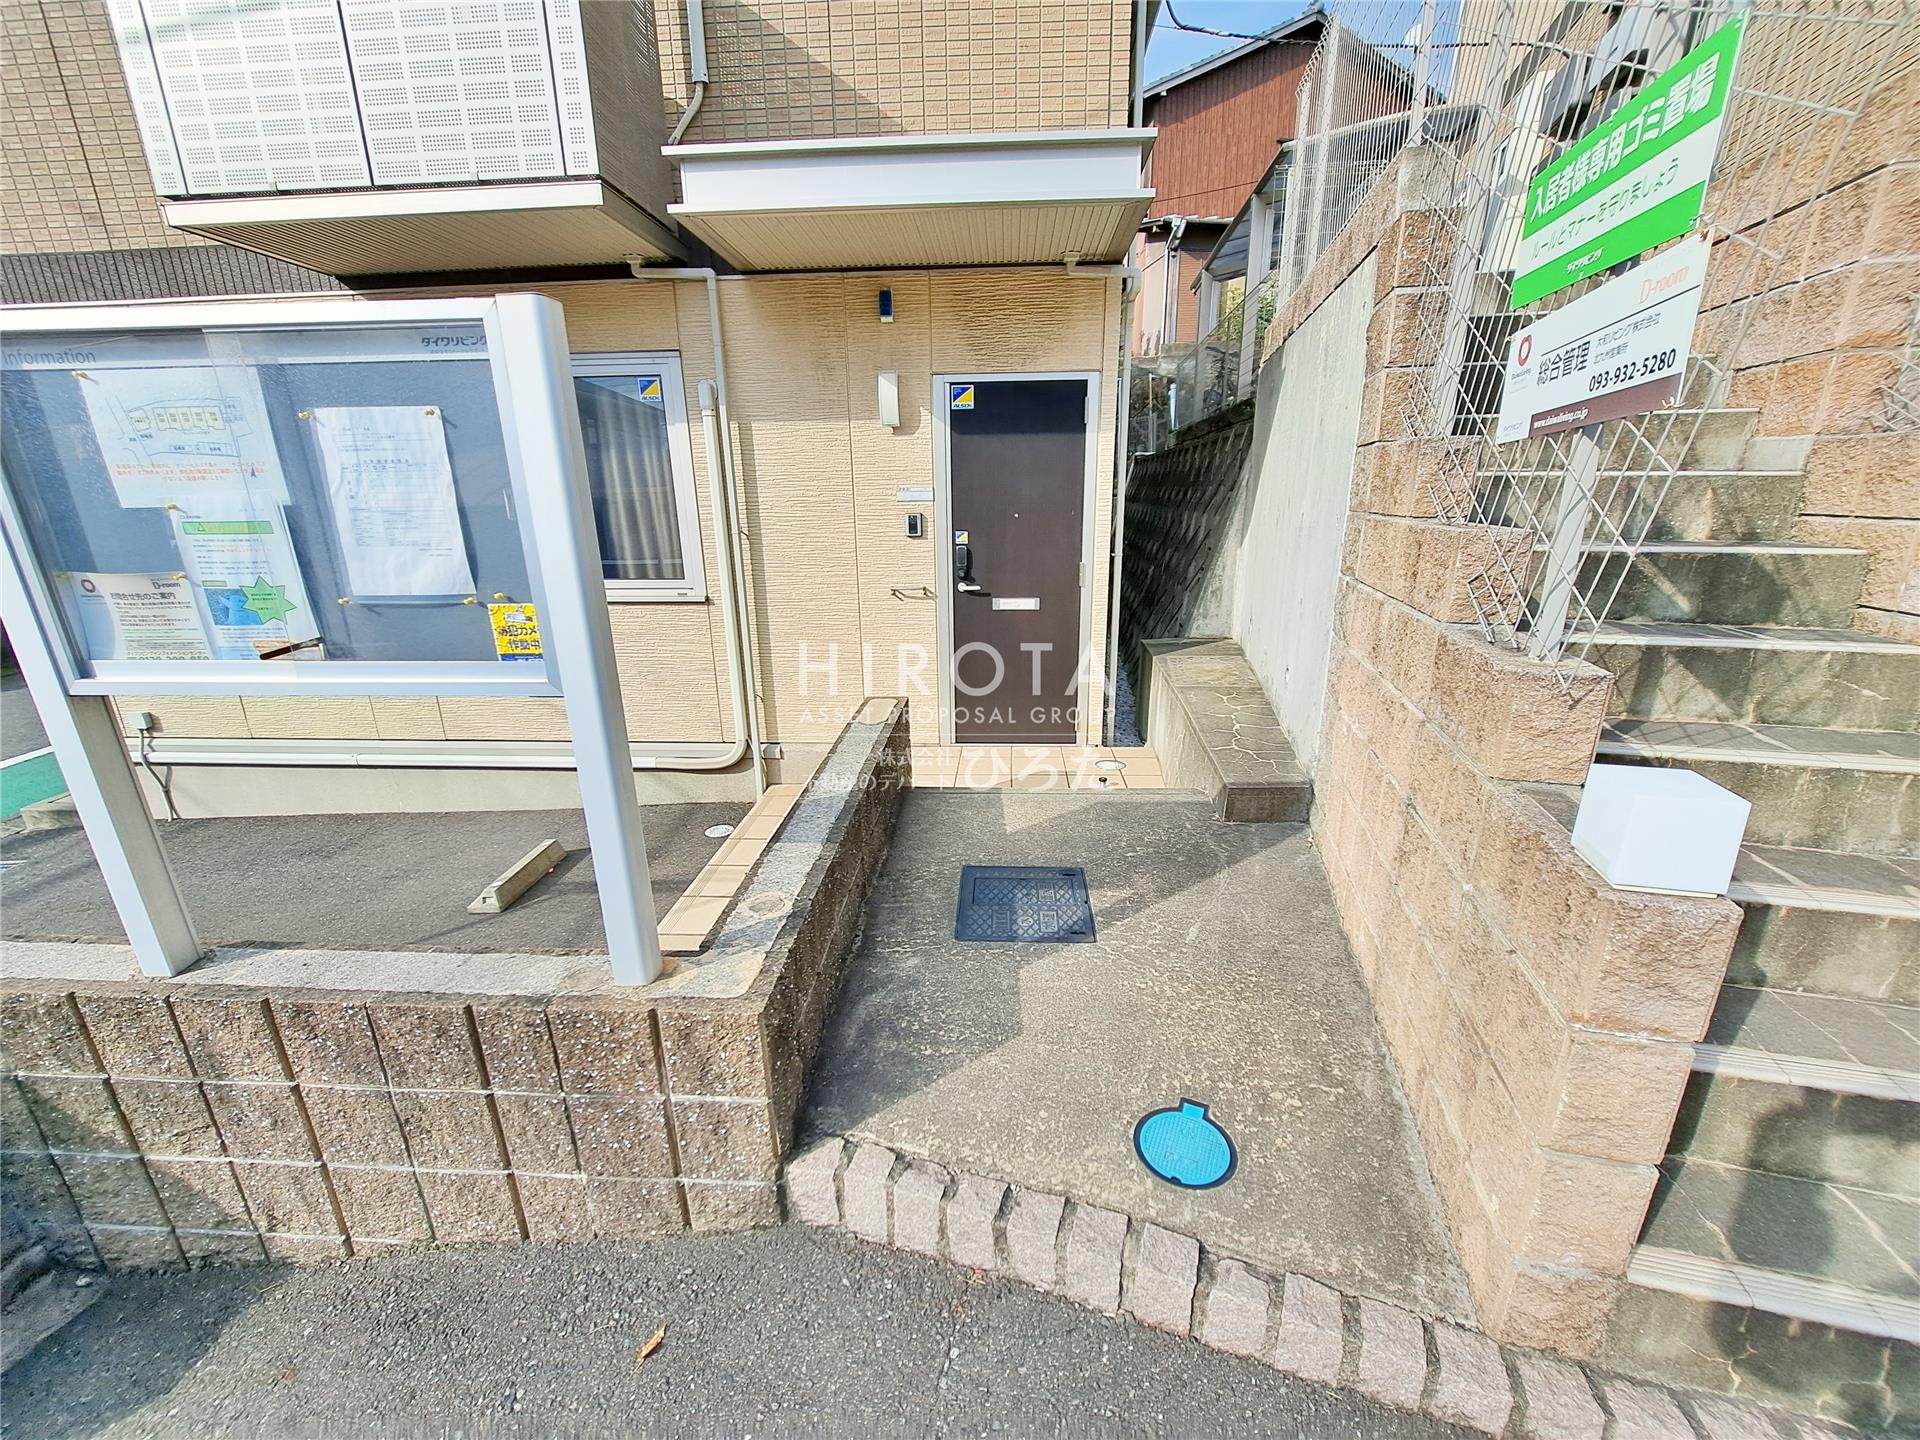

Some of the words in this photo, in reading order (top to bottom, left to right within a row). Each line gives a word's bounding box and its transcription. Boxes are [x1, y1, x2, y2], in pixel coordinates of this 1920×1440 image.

[1530, 52, 1721, 223] 入居者様専用ゴミ置場
[1531, 157, 1679, 260] ルールとマナーを守りましょう
[1639, 265, 1690, 305] D-room
[2, 348, 97, 365] Information
[421, 335, 487, 347] ダイワリビング
[1536, 340, 1591, 387] 総合管理
[1588, 348, 1677, 393] 093-932-5280
